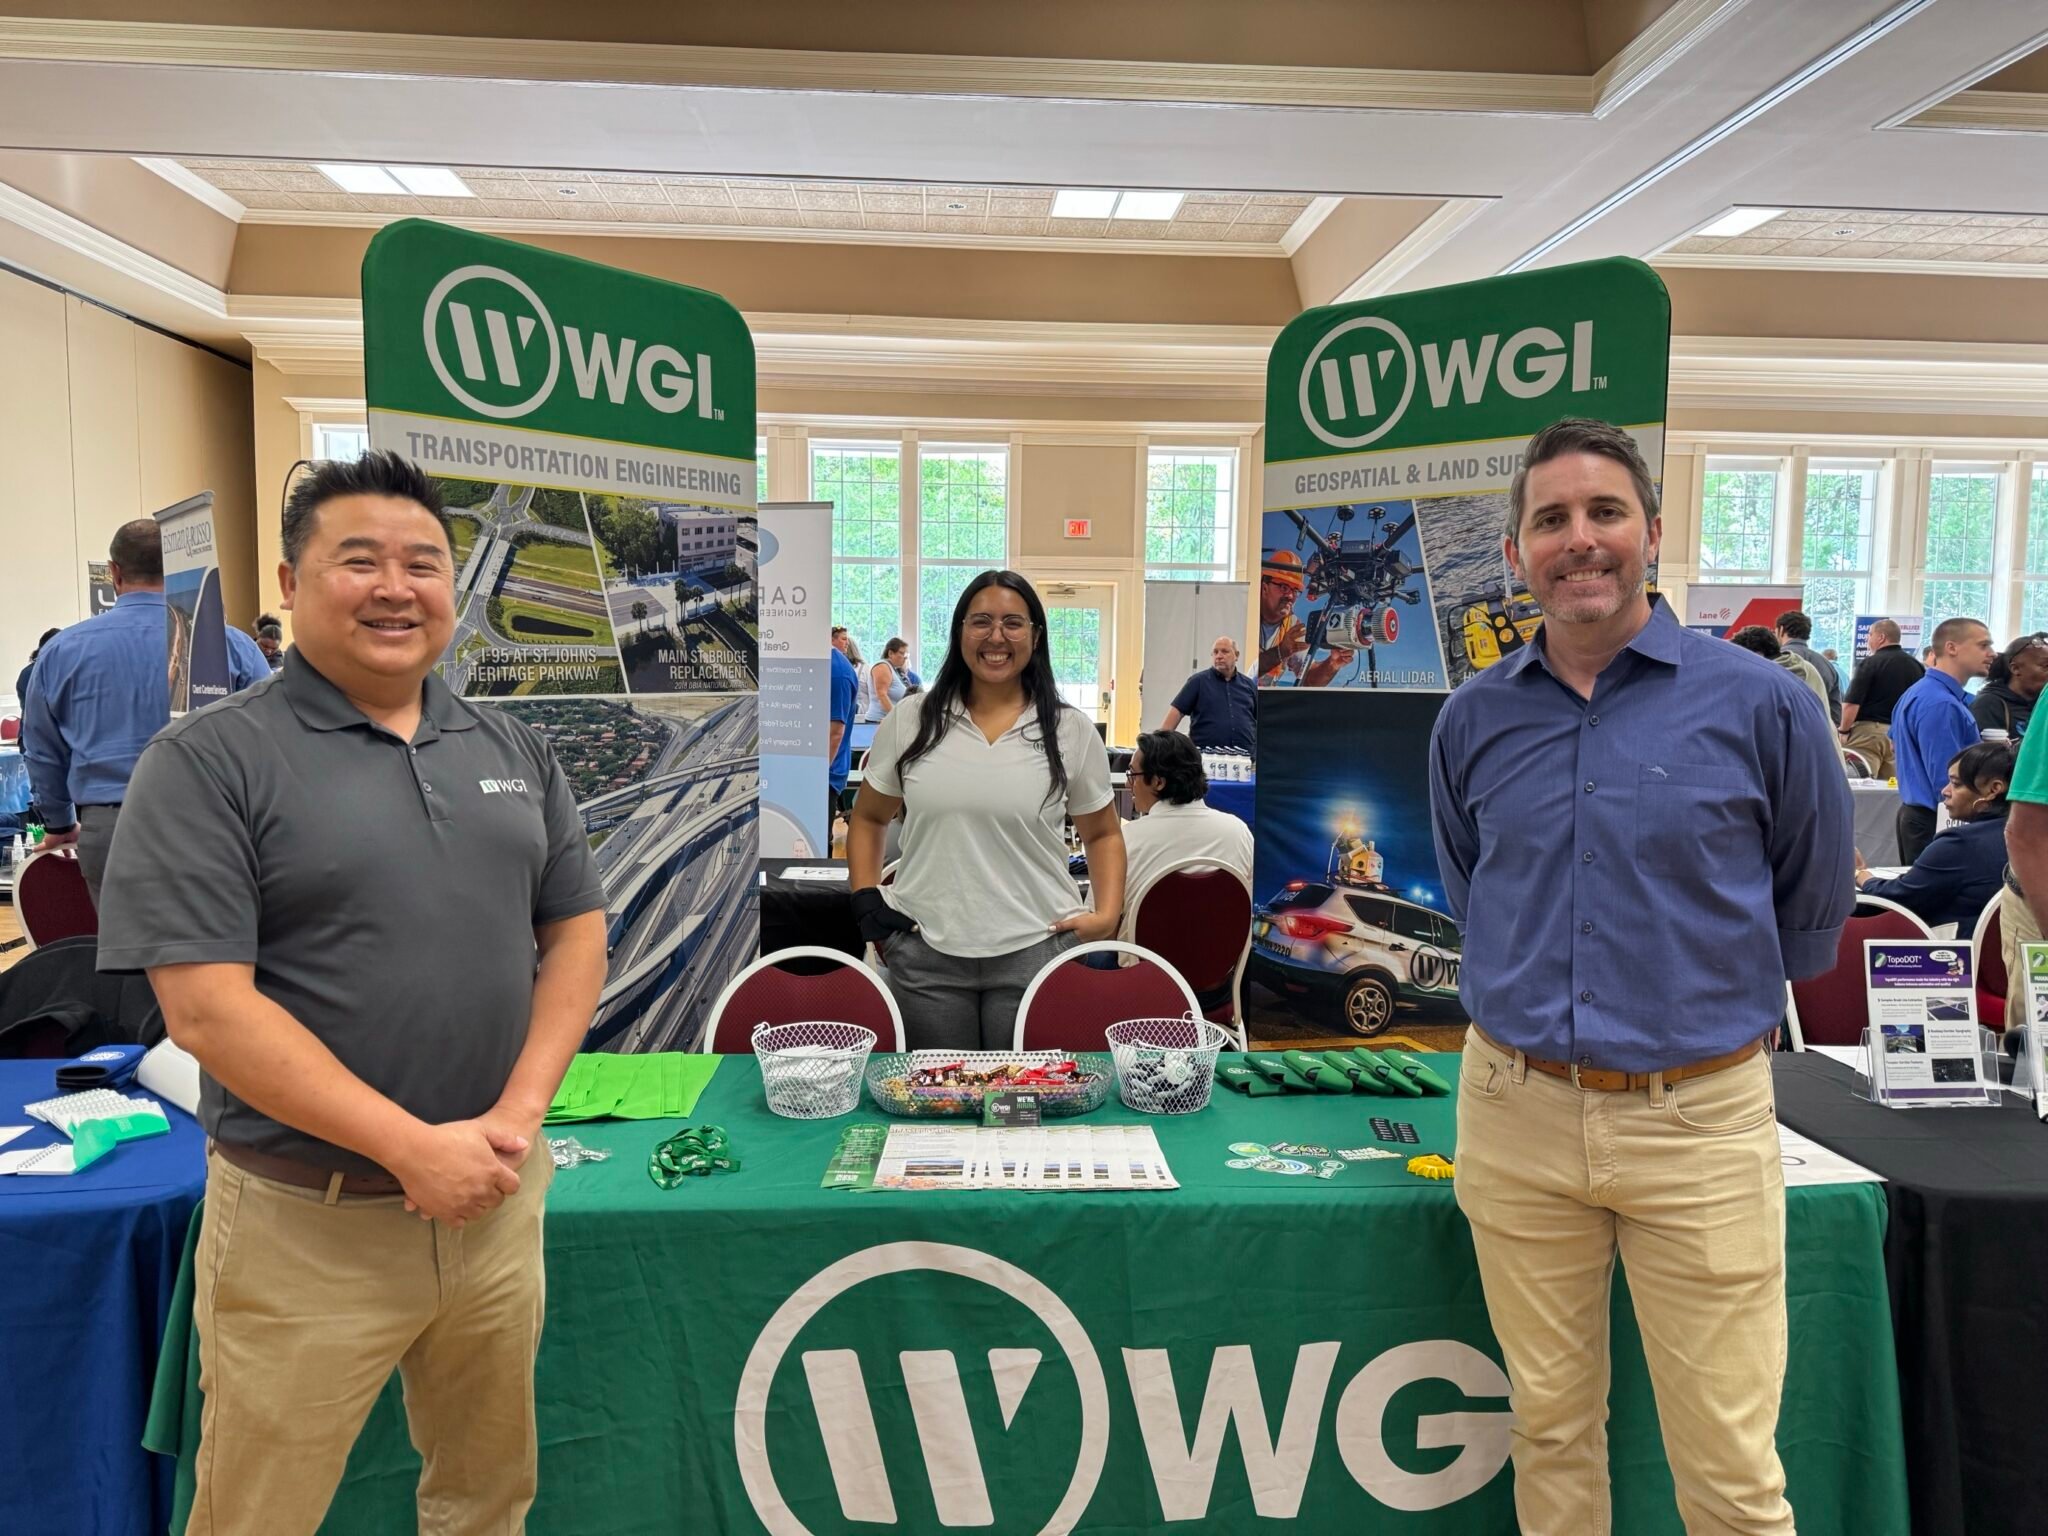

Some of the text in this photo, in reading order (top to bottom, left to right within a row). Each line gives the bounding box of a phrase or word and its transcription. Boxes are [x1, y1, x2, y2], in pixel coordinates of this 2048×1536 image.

[562, 325, 713, 420] WGI
[1420, 319, 1593, 409] WGI
[406, 431, 741, 496] TRANSPORTATION ENGINEERING
[1295, 465, 1401, 494] GEOSPATIAL
[1406, 463, 1421, 484] &
[1427, 458, 1479, 482] LAND
[481, 647, 597, 664] I-95 AT ST. JOHNS
[658, 649, 687, 664] MAIN
[709, 649, 748, 664] BRIDGE
[467, 665, 601, 682] HERITAGE PARKWAY
[669, 665, 748, 680] REPLACEMENT
[1359, 670, 1435, 684] AERIAL LIDAR
[498, 779, 528, 792] WGI
